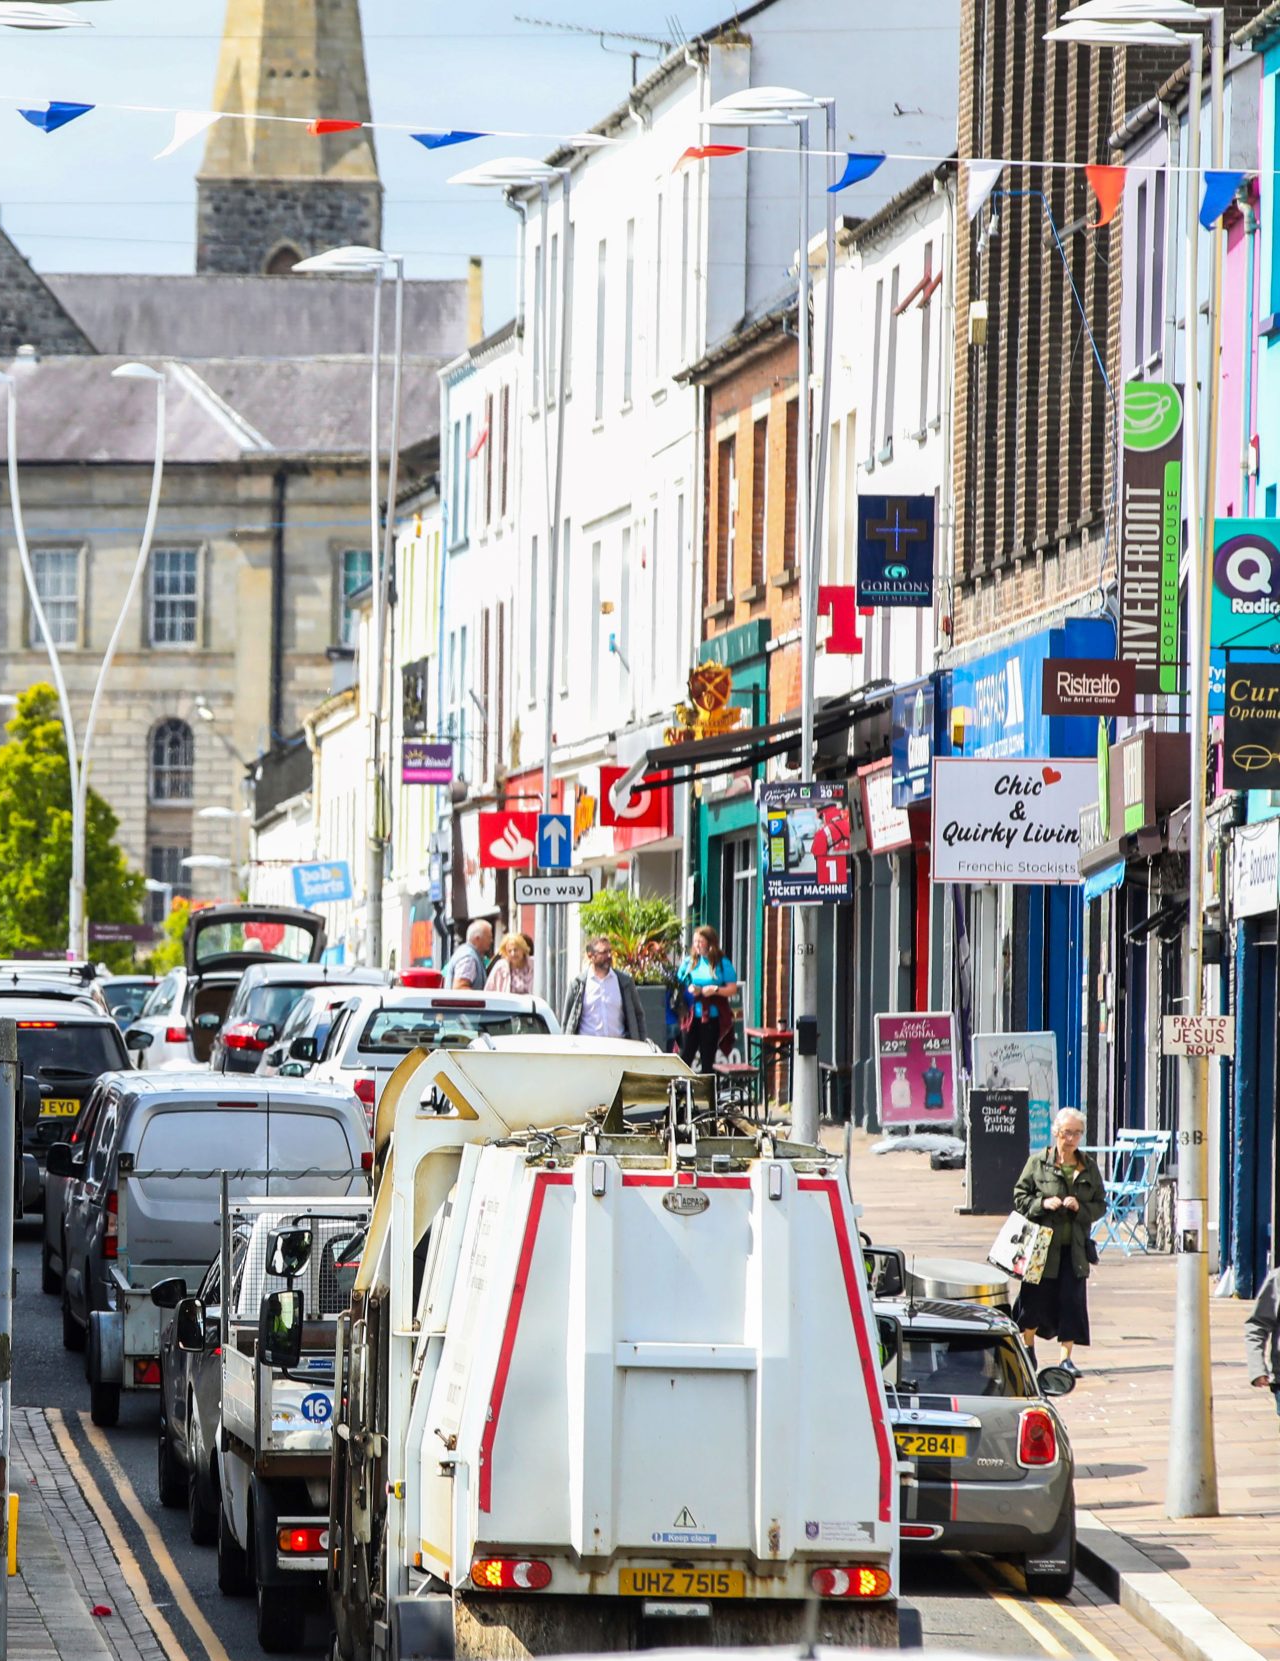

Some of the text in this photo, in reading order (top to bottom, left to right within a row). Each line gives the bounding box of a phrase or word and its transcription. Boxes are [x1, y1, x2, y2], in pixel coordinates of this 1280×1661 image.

[1163, 489, 1178, 663] COFFEE HOUSE
[1226, 547, 1272, 594] Q
[861, 580, 930, 592] GORDONS
[1057, 671, 1120, 696] Ristretto
[994, 775, 1042, 795] Chic
[1009, 800, 1027, 821] &
[942, 821, 1018, 849] Quirky
[1023, 822, 1081, 848] Livin
[826, 860, 837, 882] 1
[958, 861, 1076, 874] Frenchic Stockists
[522, 885, 584, 898] One way
[768, 884, 848, 896] TICKET MACHINE
[1173, 1017, 1226, 1028] PRAY TO
[894, 1030, 935, 1039] SATIONAL
[1172, 1029, 1225, 1043] JESUS
[1186, 1045, 1215, 1055] NOW
[984, 1115, 1016, 1124] Quirky
[985, 1123, 1016, 1134] Living
[305, 1399, 327, 1417] 16
[977, 1458, 1004, 1467] COOPER
[668, 1534, 711, 1543] Keep clear
[633, 1572, 730, 1594] UHZ 7515
